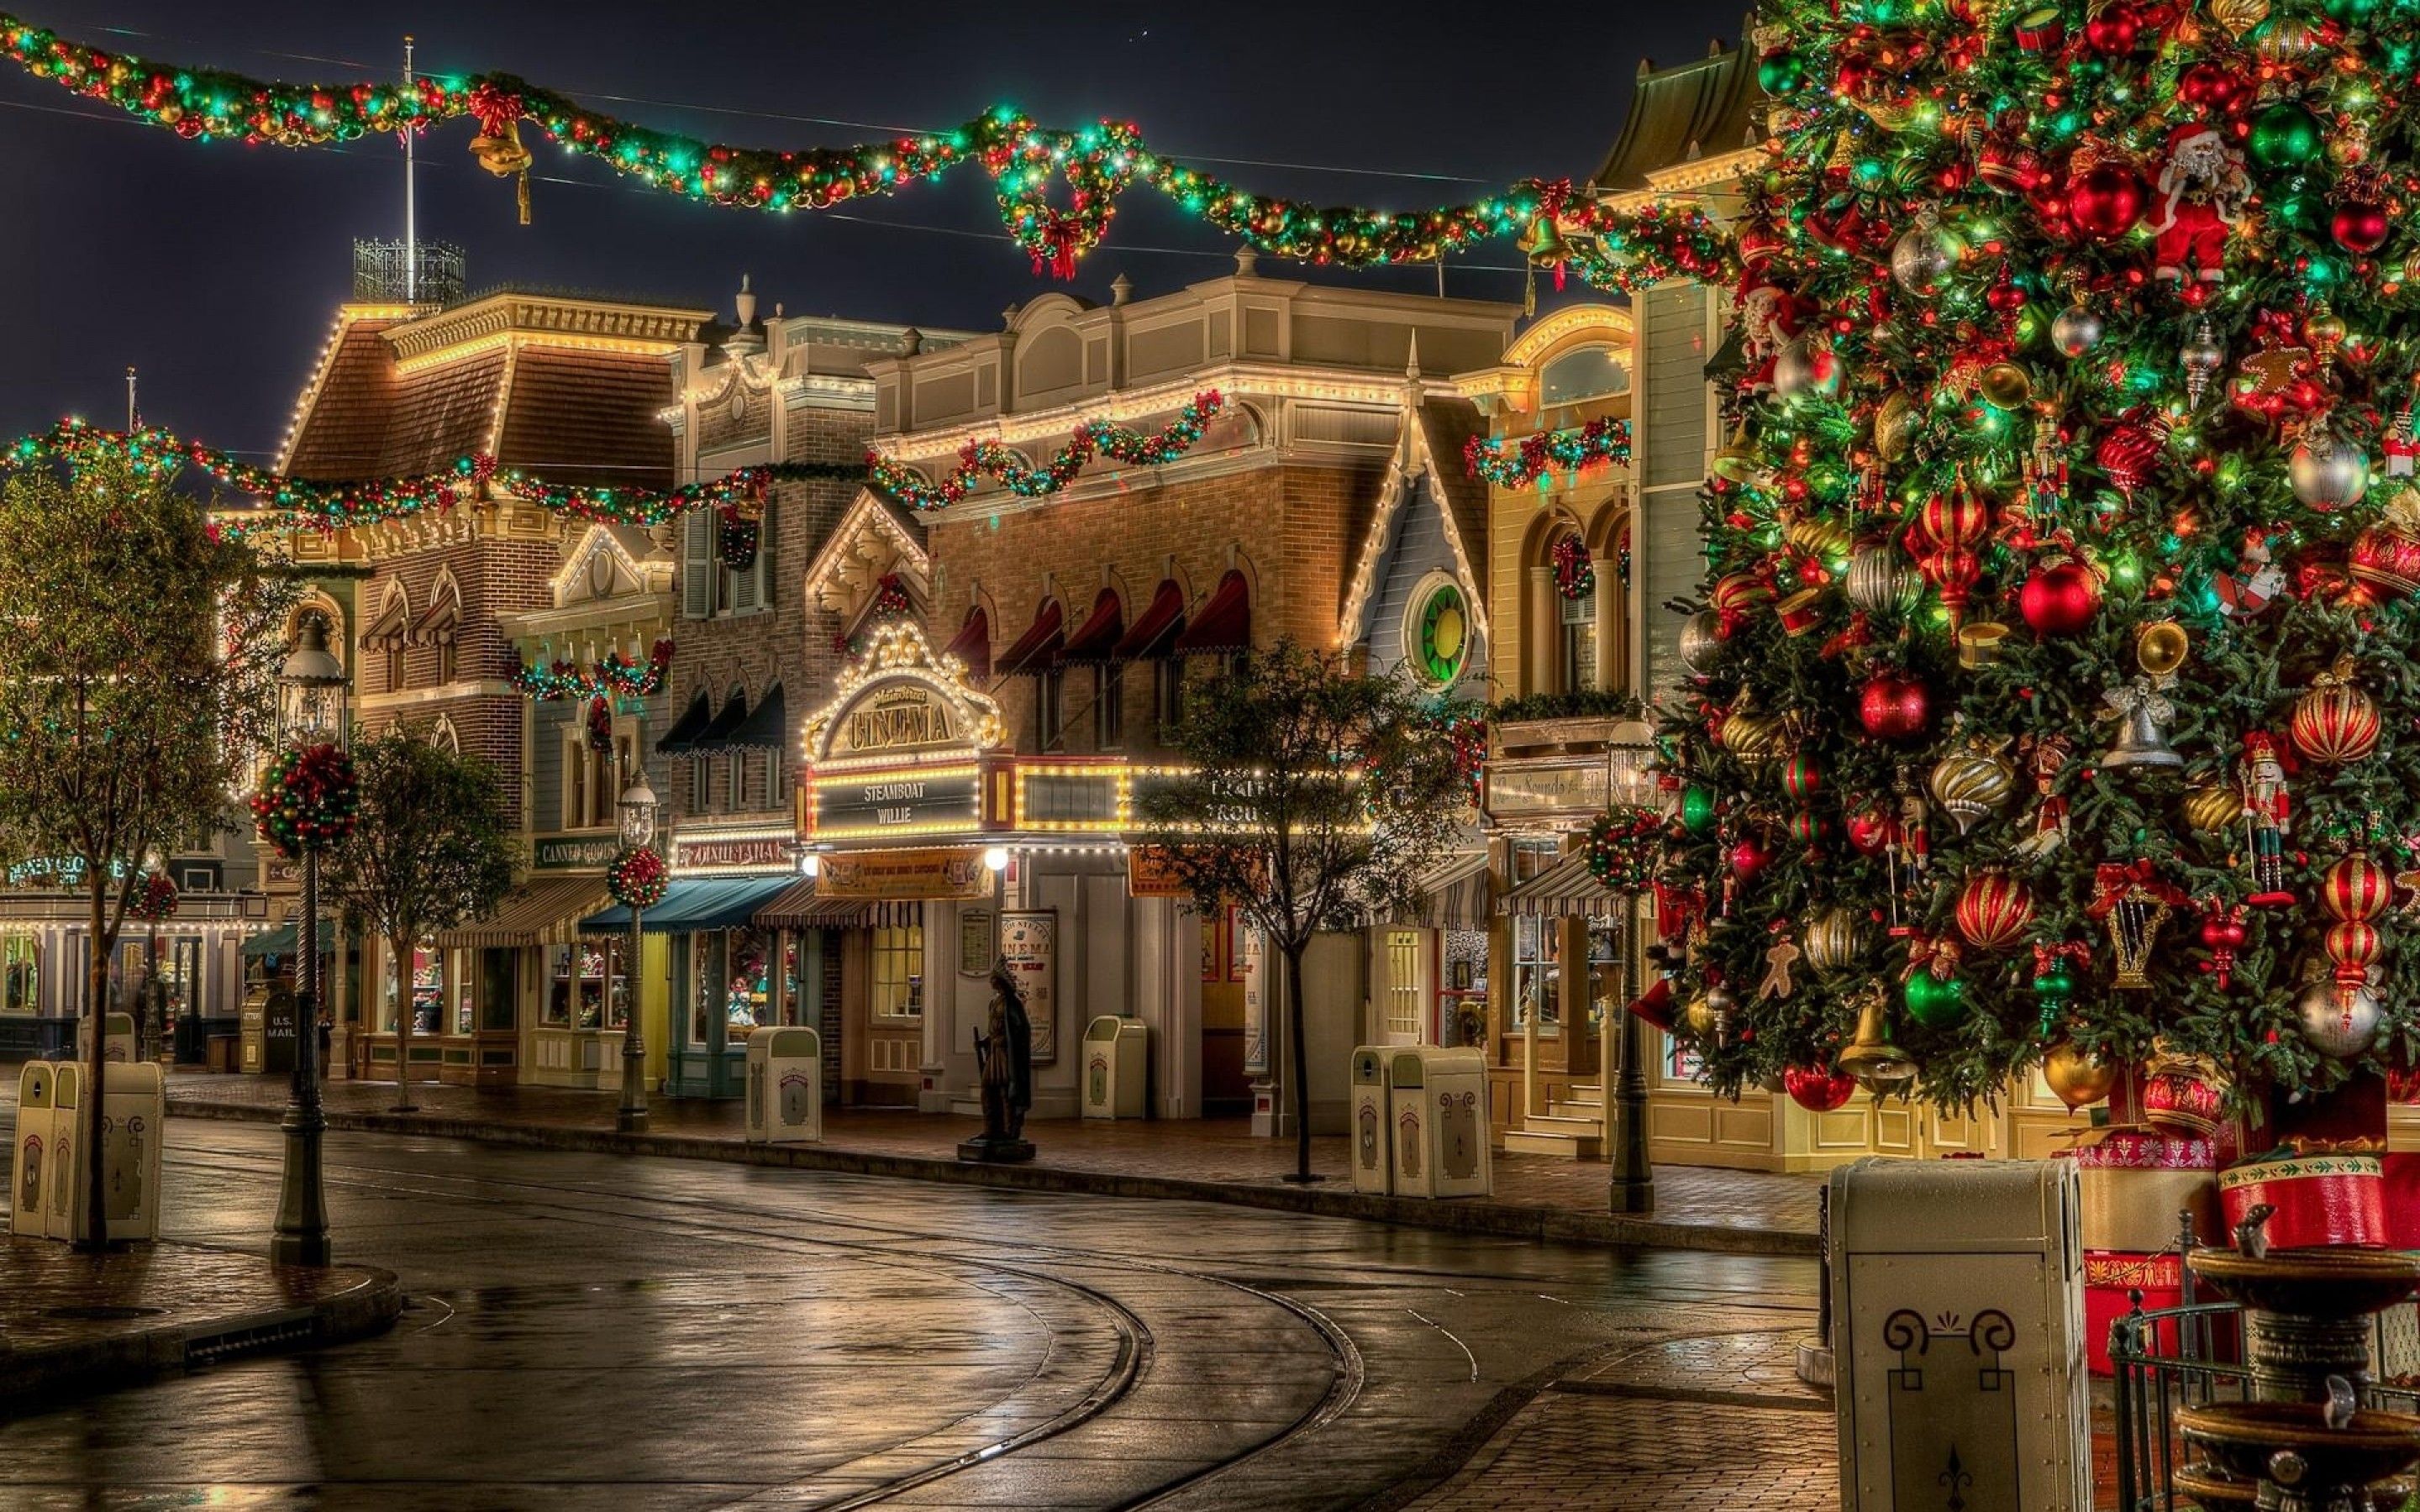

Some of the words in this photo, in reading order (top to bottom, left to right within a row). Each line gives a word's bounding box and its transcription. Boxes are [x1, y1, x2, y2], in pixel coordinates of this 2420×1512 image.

[849, 703, 952, 750] CINEMA
[863, 782, 926, 802] STEAMBOAT
[876, 806, 913, 825] WILLIE
[543, 843, 581, 863] CANNED
[273, 1016, 293, 1026] U.S.
[267, 1028, 297, 1038] MAIL
